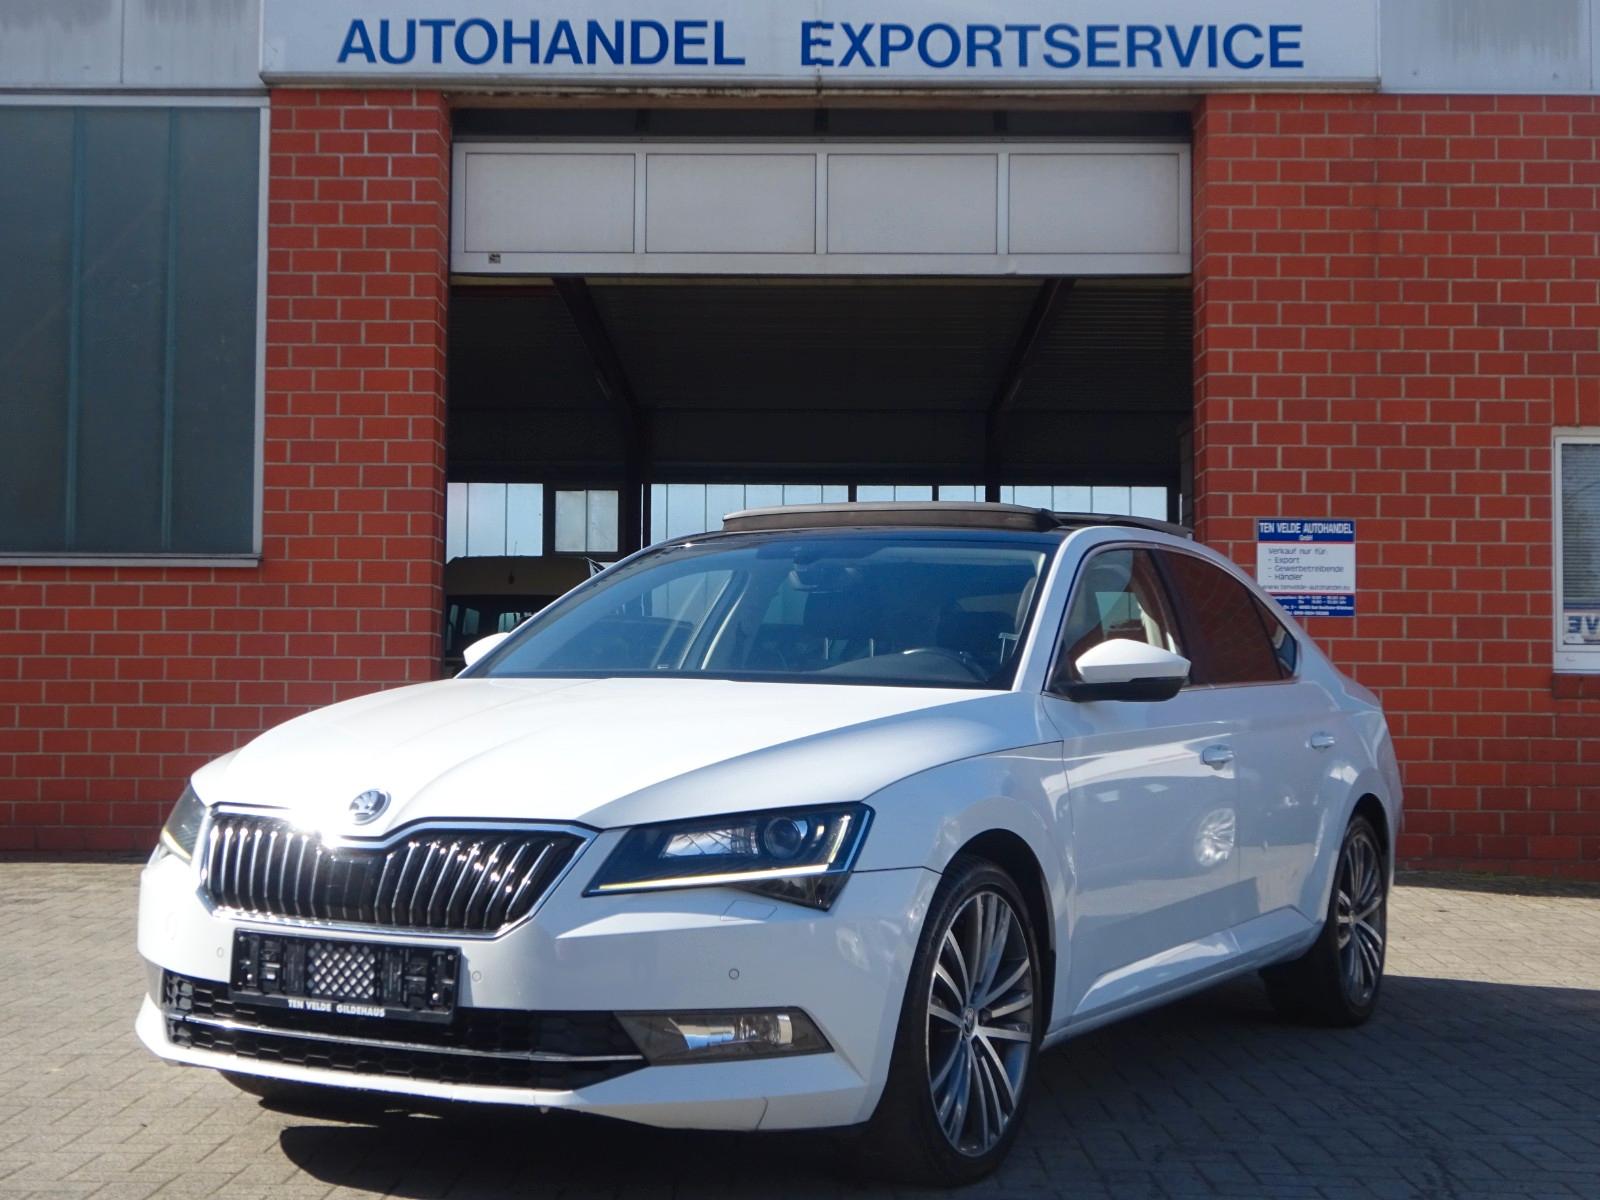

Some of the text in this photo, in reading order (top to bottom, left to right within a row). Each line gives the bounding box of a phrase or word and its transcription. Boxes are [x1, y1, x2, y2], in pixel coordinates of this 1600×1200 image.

[336, 18, 1304, 70] AUTOHANDEL EXPORTSERVICE
[1259, 522, 1353, 534] TEN VELDE AUTOHANDEL
[1268, 547, 1297, 555] Verkauf
[1314, 547, 1327, 555] für
[1274, 556, 1300, 564] Export
[288, 998, 386, 1018] TEN VELDE GILDEHAUS
